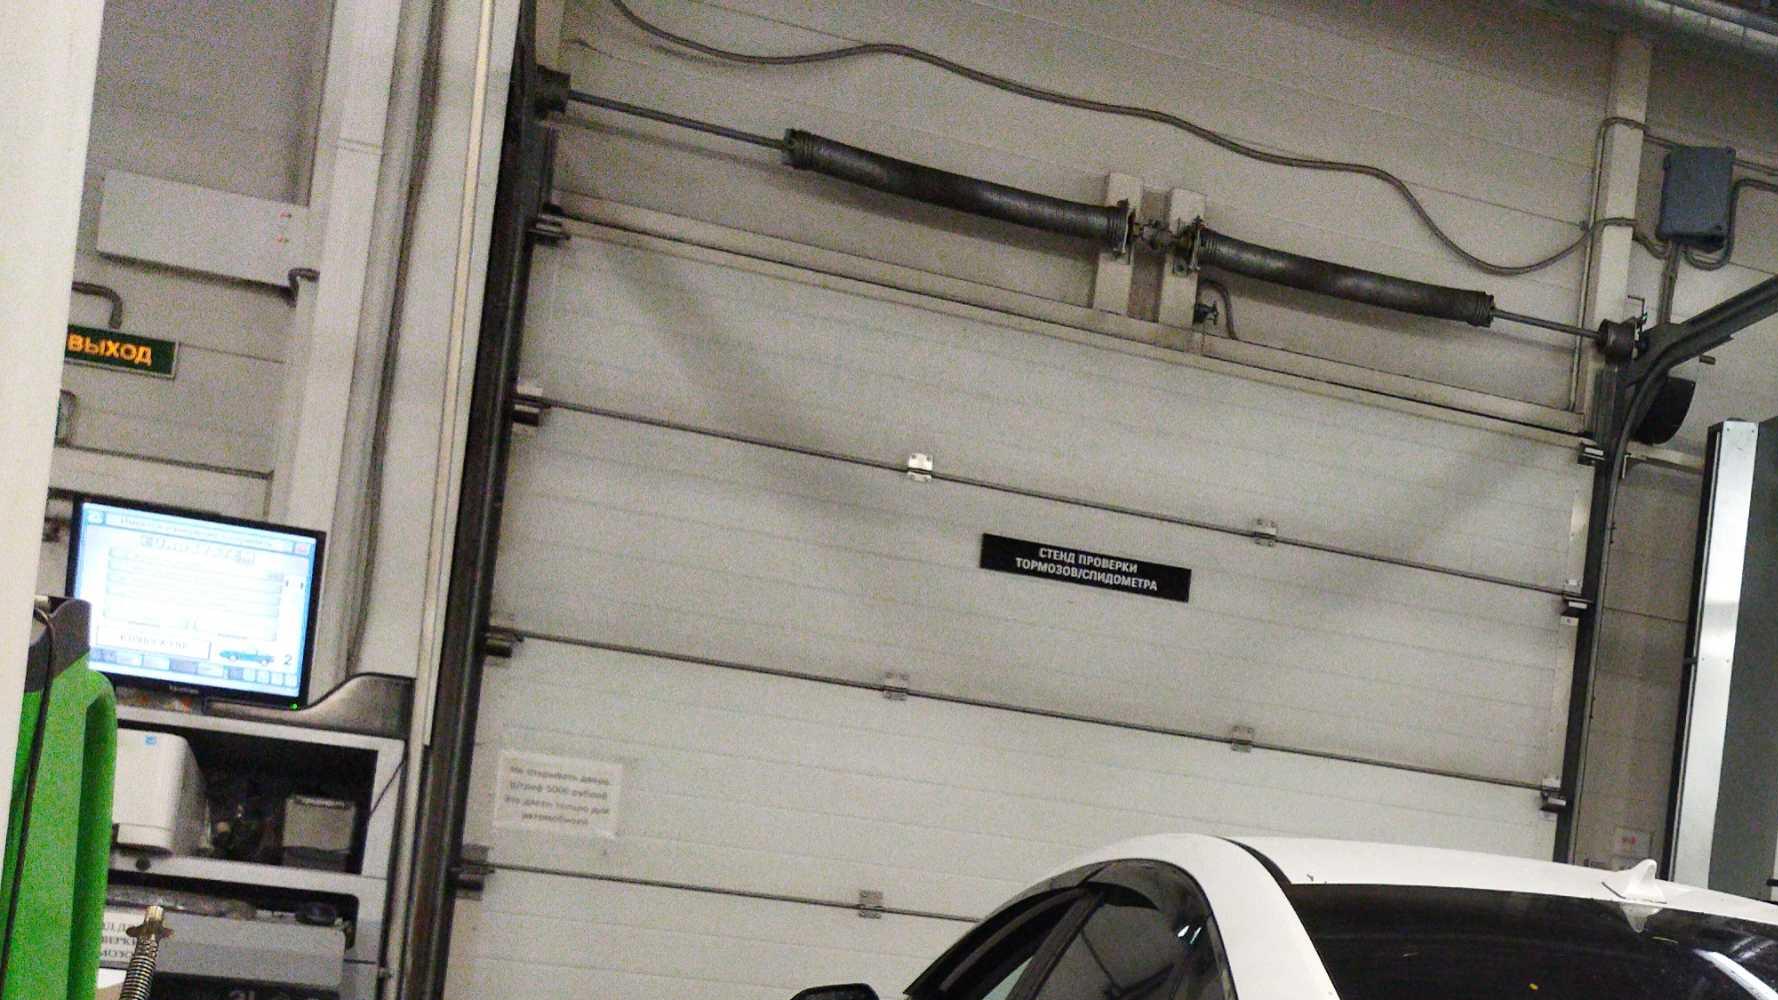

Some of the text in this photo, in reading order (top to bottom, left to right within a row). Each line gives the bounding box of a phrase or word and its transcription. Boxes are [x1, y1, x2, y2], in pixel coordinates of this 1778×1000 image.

[67, 333, 153, 367] ВЫХОД
[1015, 557, 1158, 592] ТОРМОЗОВ/СПИДОМЕТРА
[1038, 546, 1138, 574] СТЕНД ПРОВЕРКИ
